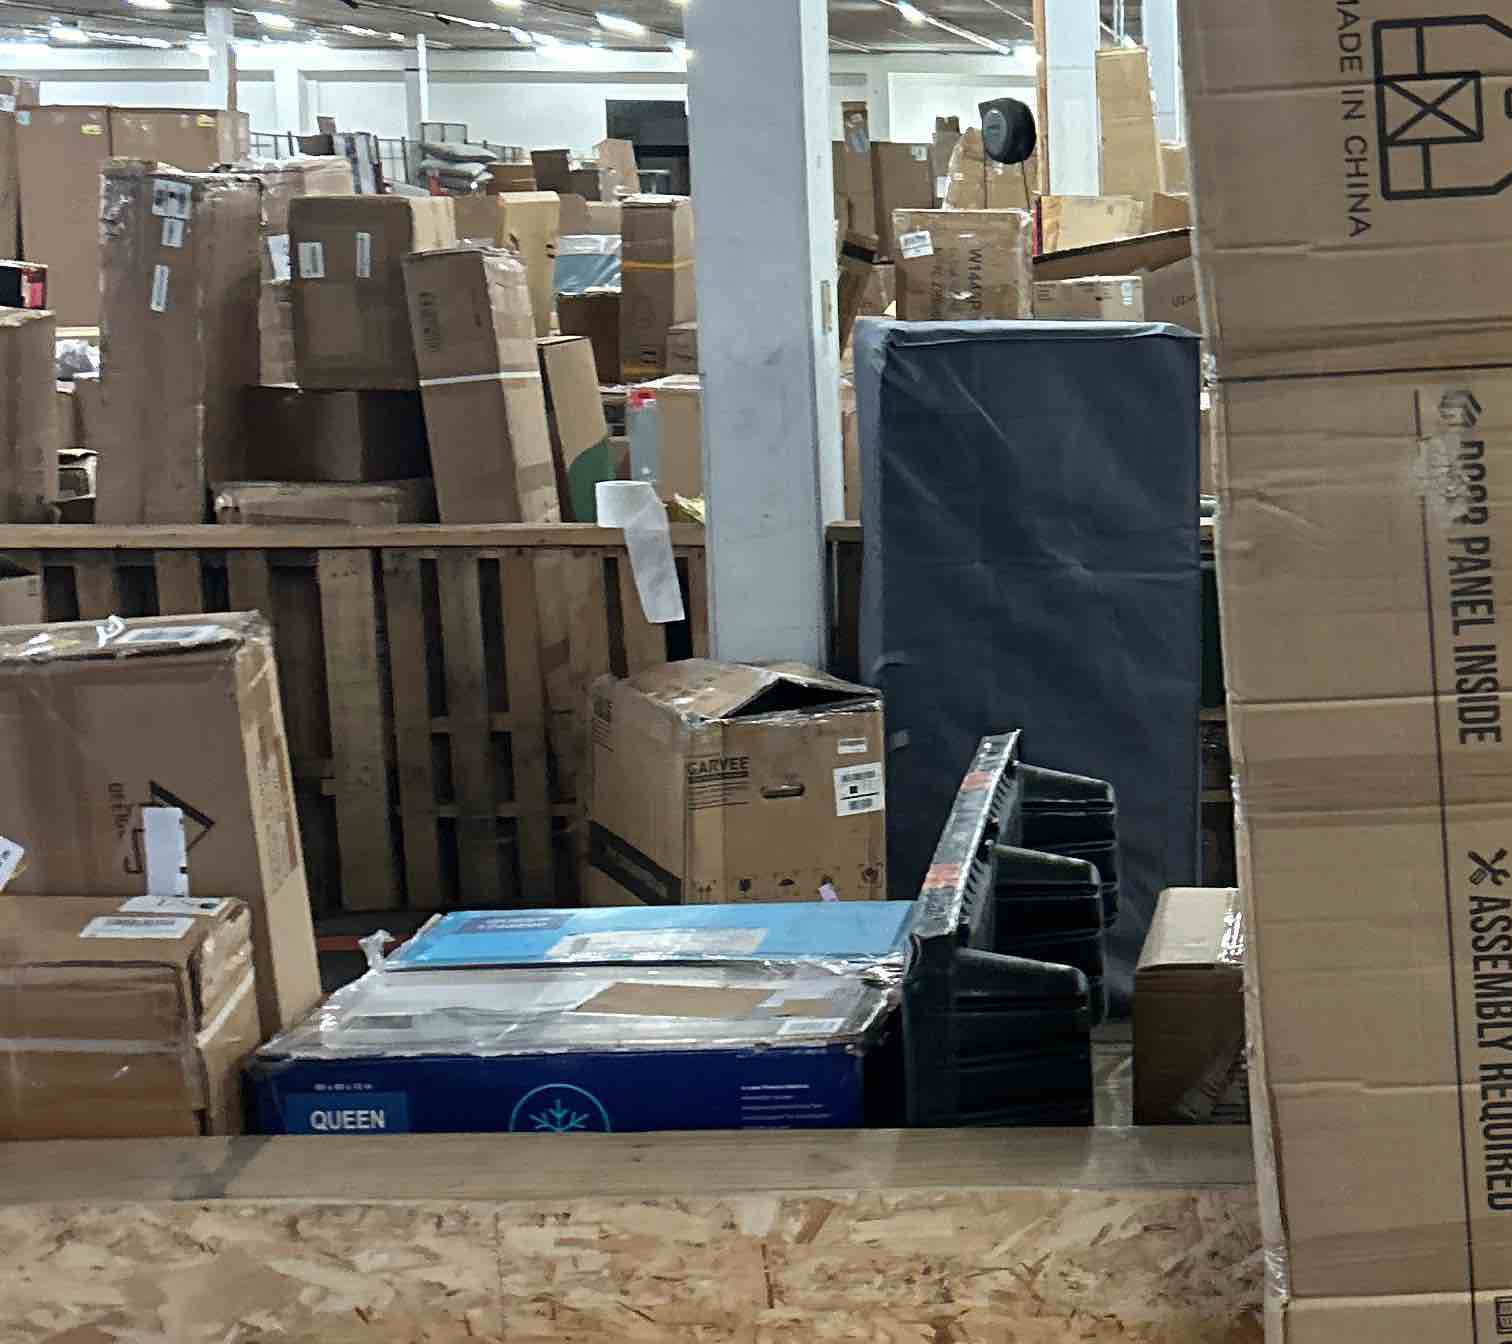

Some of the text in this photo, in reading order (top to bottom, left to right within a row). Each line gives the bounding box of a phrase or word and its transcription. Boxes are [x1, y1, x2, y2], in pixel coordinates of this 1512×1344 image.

[1341, 89, 1365, 120] IN
[1344, 135, 1371, 238] CHINA
[1448, 536, 1496, 636] PANEL
[1453, 644, 1502, 745] INSIDE
[687, 757, 749, 776] GARVEE
[310, 1109, 385, 1131] QUEEN
